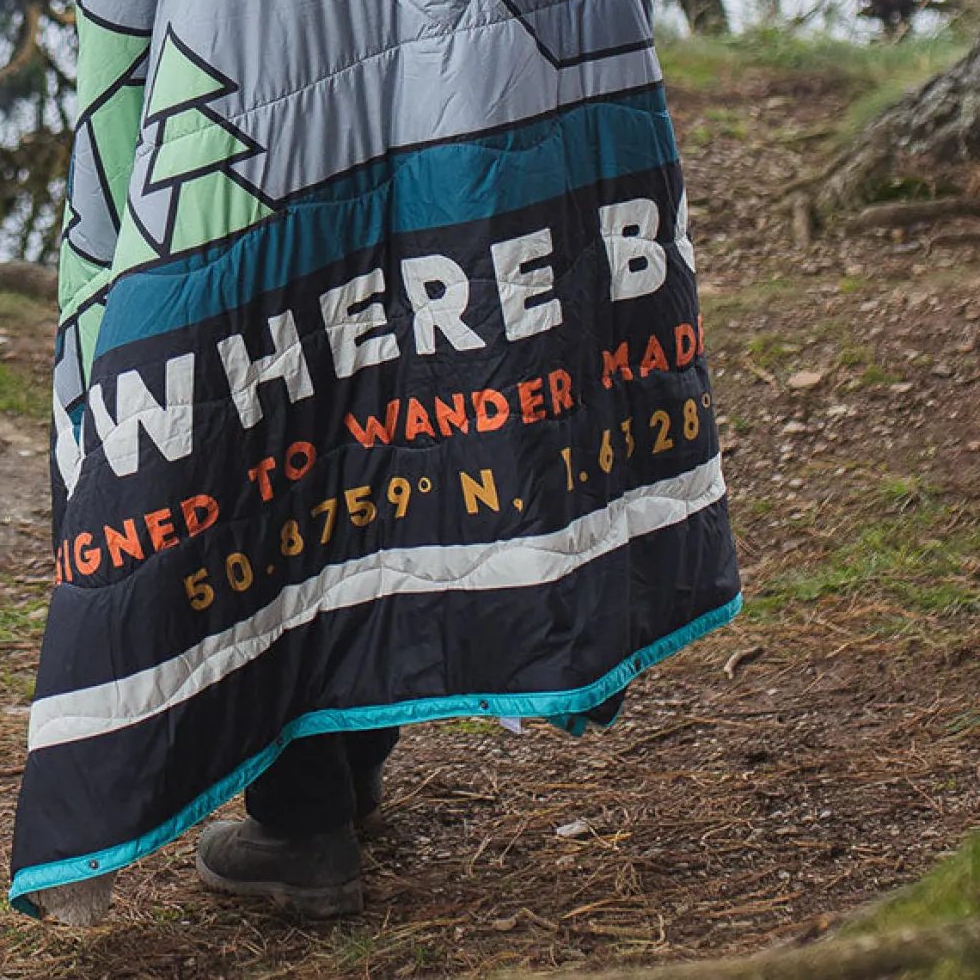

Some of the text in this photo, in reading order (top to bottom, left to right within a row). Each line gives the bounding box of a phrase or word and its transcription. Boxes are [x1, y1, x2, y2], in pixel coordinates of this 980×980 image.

[248, 440, 317, 502] TO
[345, 368, 574, 449] WANDER
[460, 468, 524, 514] N,
